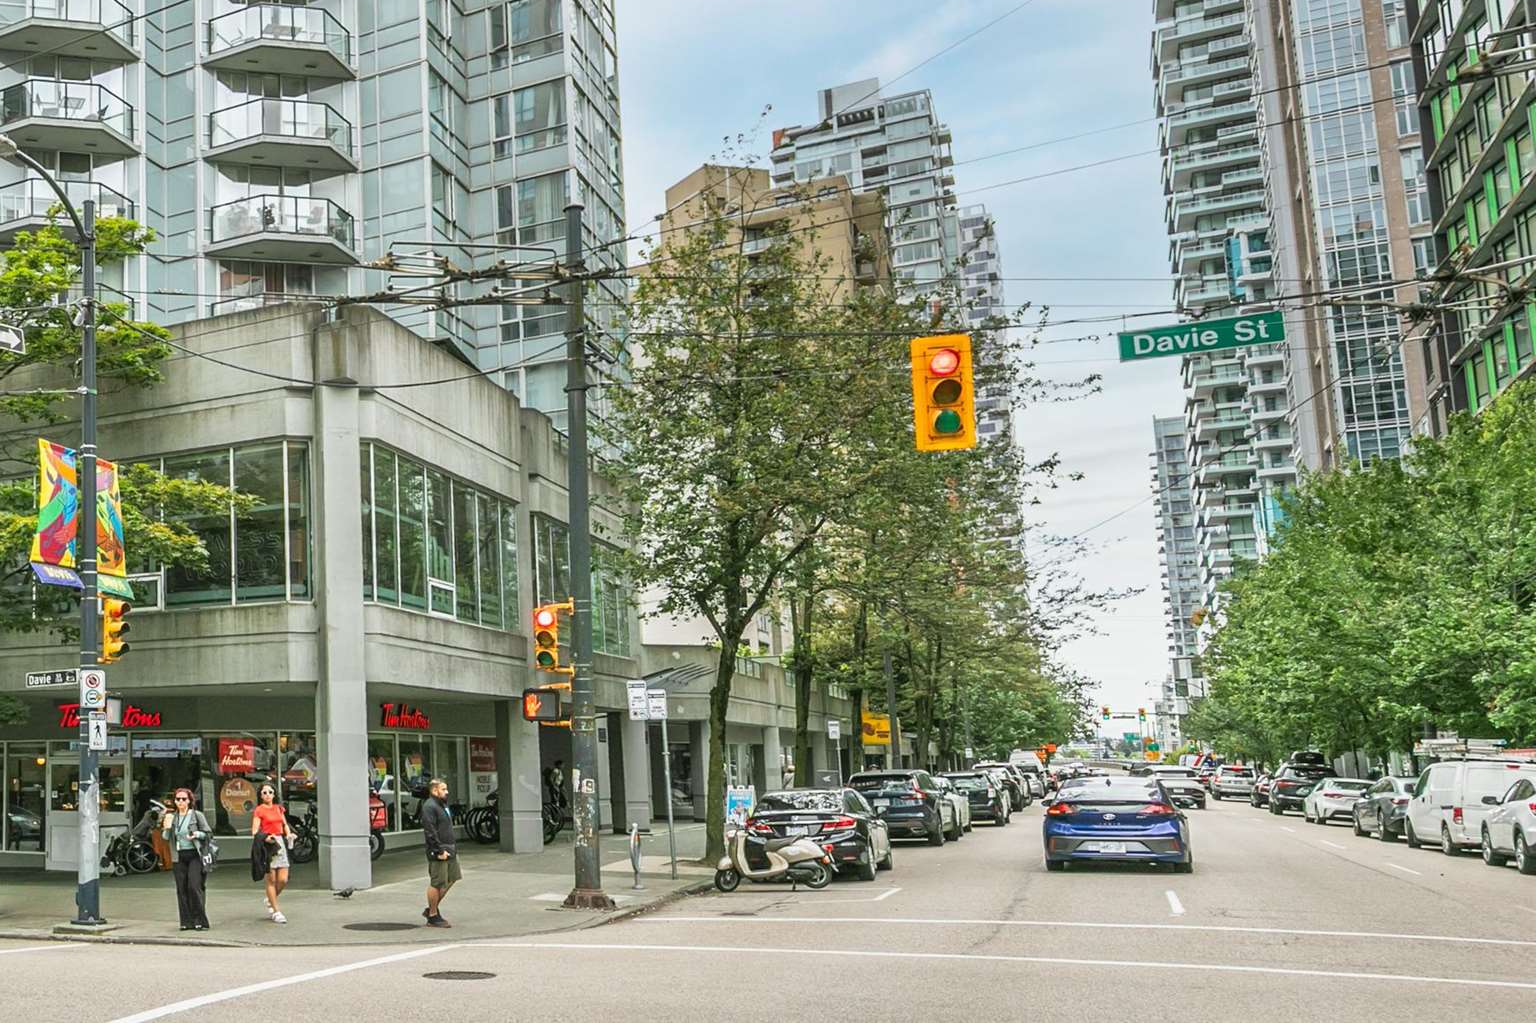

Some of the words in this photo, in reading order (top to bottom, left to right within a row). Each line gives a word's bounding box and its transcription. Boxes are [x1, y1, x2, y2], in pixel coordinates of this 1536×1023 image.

[1133, 327, 1219, 356] Davie
[1234, 319, 1270, 343] St
[28, 674, 52, 685] Davie
[58, 703, 81, 727] Ti
[122, 704, 161, 728] tons
[382, 703, 399, 728] Tim
[399, 703, 431, 729] Hortons
[228, 745, 243, 756] Tim
[222, 756, 252, 766] Hortons
